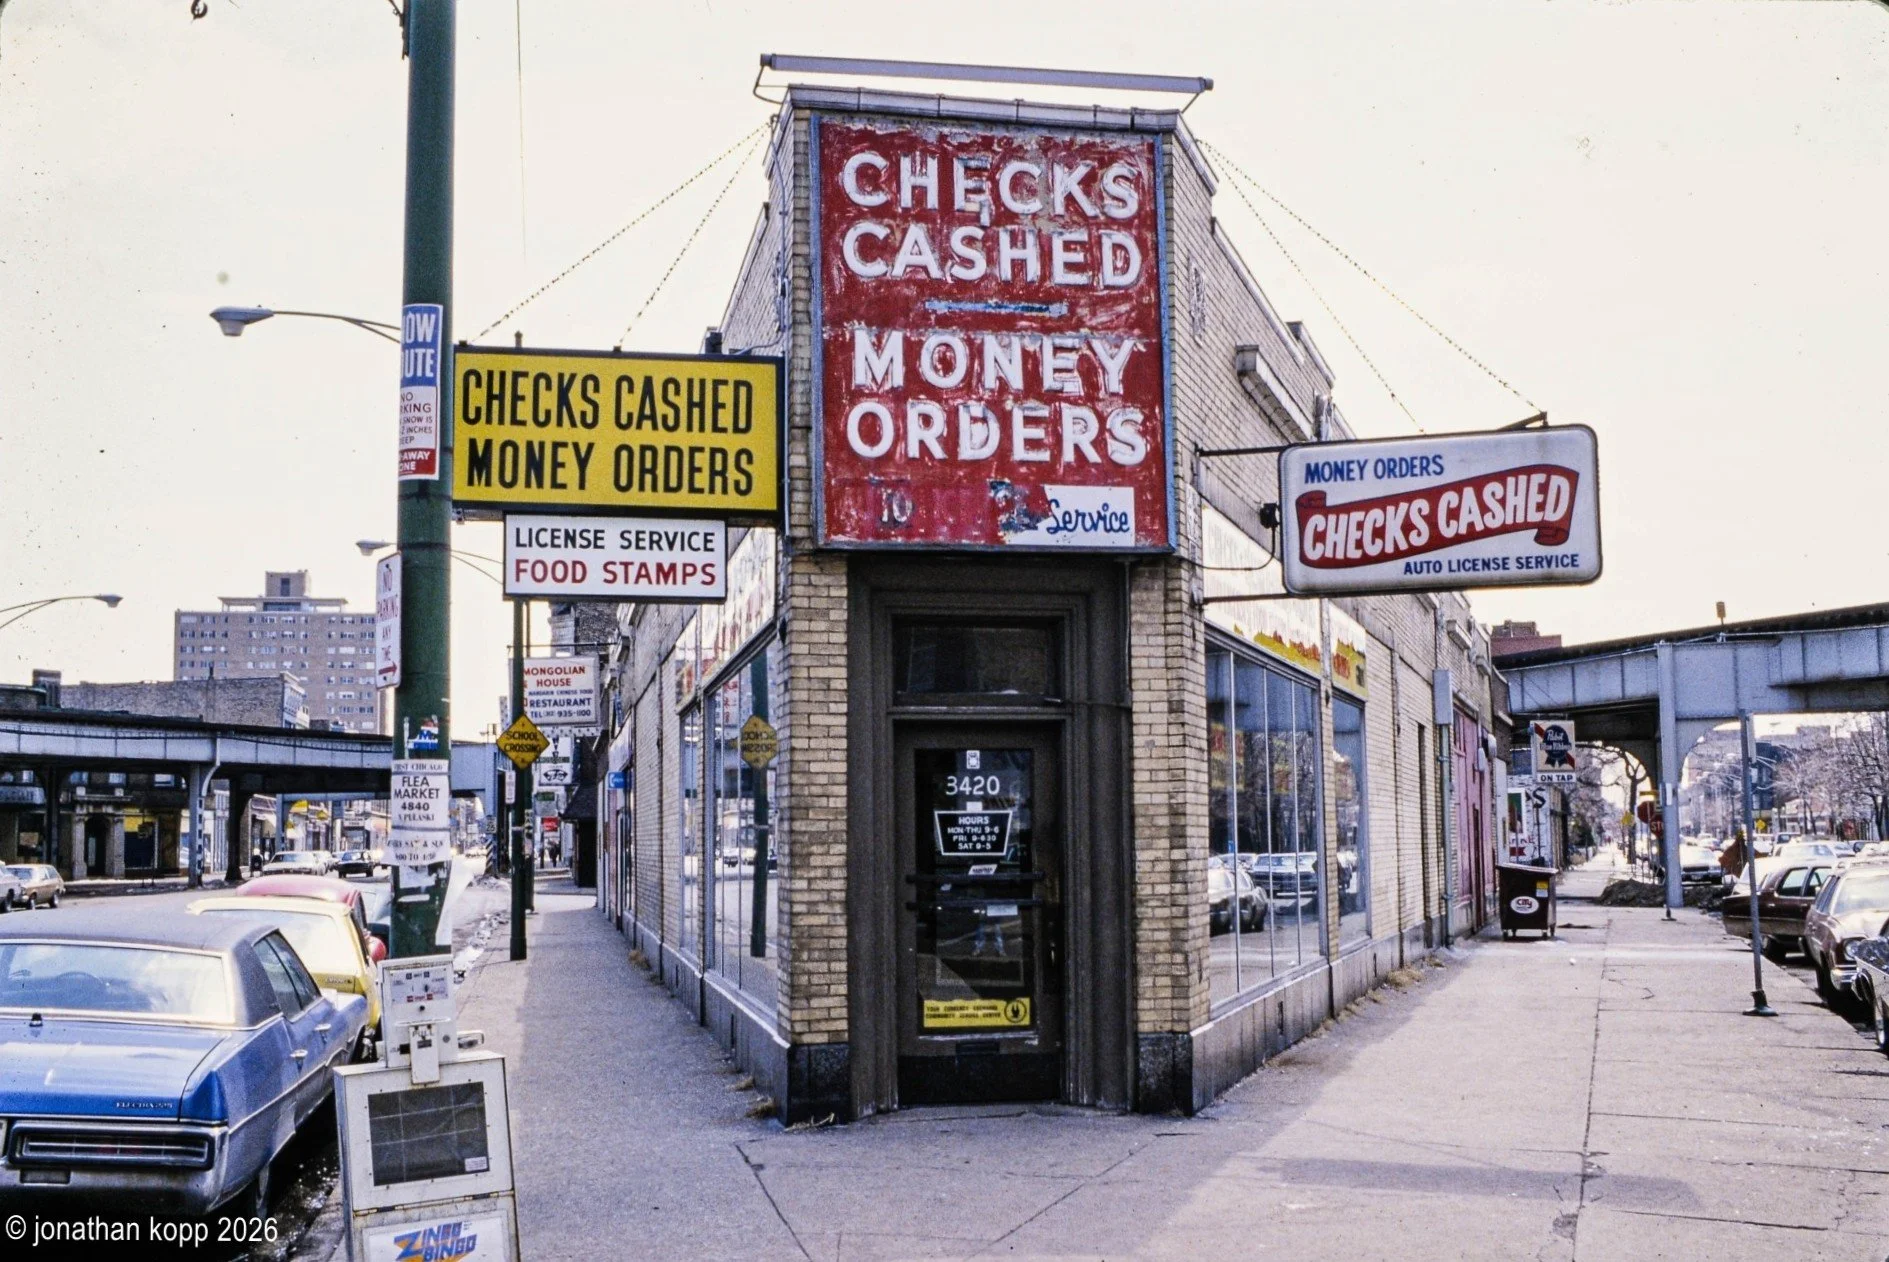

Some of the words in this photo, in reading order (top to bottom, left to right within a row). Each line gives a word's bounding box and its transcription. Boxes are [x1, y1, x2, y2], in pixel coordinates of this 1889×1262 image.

[842, 151, 1140, 221] CHECKS
[842, 221, 1142, 288] CASHED
[853, 329, 1137, 394] MONEY
[462, 369, 600, 429] CHECKS
[614, 375, 754, 434] CASHED
[847, 401, 1147, 465] ORDERS
[467, 438, 595, 490] MONEY
[614, 443, 754, 496] ORDERS
[1304, 458, 1369, 484] MONEY
[1373, 455, 1445, 479] ORDERS
[1046, 499, 1131, 534] Service
[1303, 499, 1431, 560] CHECKS
[1437, 473, 1571, 534] CASHED
[515, 528, 606, 550] LICENSE
[619, 530, 716, 552] SERVICE
[514, 559, 588, 584] FOOD
[603, 561, 716, 586] STAMPS
[1403, 560, 1443, 575] AUTO
[1448, 557, 1509, 573] LICENSE
[1515, 554, 1580, 570] SERVICE
[524, 666, 586, 676] MONGOLIAN
[536, 679, 571, 687] HOUSE
[530, 698, 592, 708] RESTAURANT
[507, 731, 540, 741] SCHOOL
[504, 743, 541, 752] CROSSING
[402, 776, 430, 787] FLEA
[945, 775, 1000, 795] 3420
[1556, 774, 1573, 782] TAP
[394, 788, 440, 799] MARKET
[401, 802, 430, 811] 4840
[958, 816, 989, 824] HOURS
